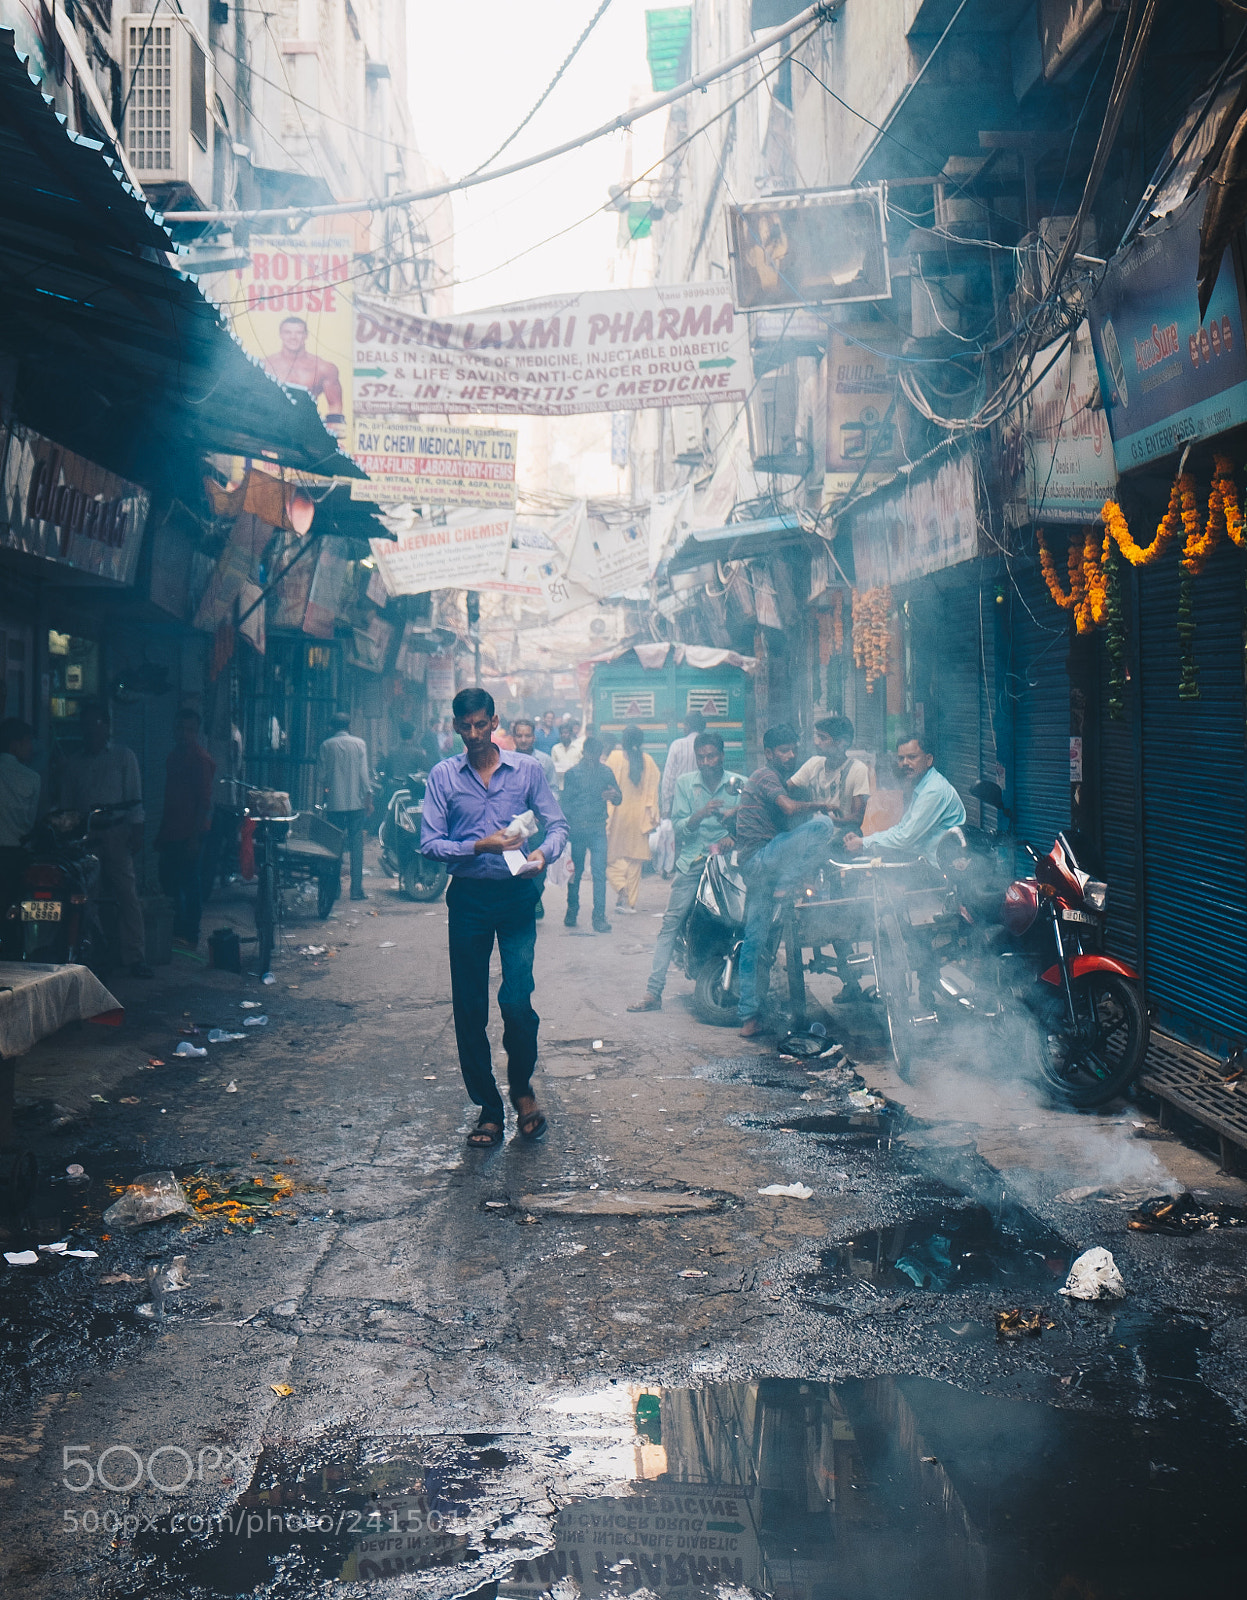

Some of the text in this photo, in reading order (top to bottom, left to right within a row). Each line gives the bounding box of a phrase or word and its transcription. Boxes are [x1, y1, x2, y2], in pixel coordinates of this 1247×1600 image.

[248, 284, 337, 312] HOUSE
[355, 313, 453, 348] DHAN
[463, 316, 576, 350] LAXMI
[588, 302, 734, 346] PHARMA
[356, 350, 399, 364] DEALS
[429, 352, 453, 366] ALL
[458, 354, 490, 366] TYPE
[494, 356, 511, 367] OF
[515, 352, 583, 368] MEDICINE,
[587, 346, 665, 365] INJECTABLE
[670, 341, 729, 357] DIABETIC
[394, 360, 695, 383] & LIFE SAVING ANTI-CANCER DRUG
[358, 382, 403, 399] SPL.
[616, 373, 731, 396] MEDICINE
[358, 433, 515, 460] RAY CHEM MEDICA PVT. LTD.
[1145, 417, 1196, 454] ENTERPRISES
[419, 457, 515, 480] LABORATORY-ITEMS
[455, 520, 509, 543] CHEMIST
